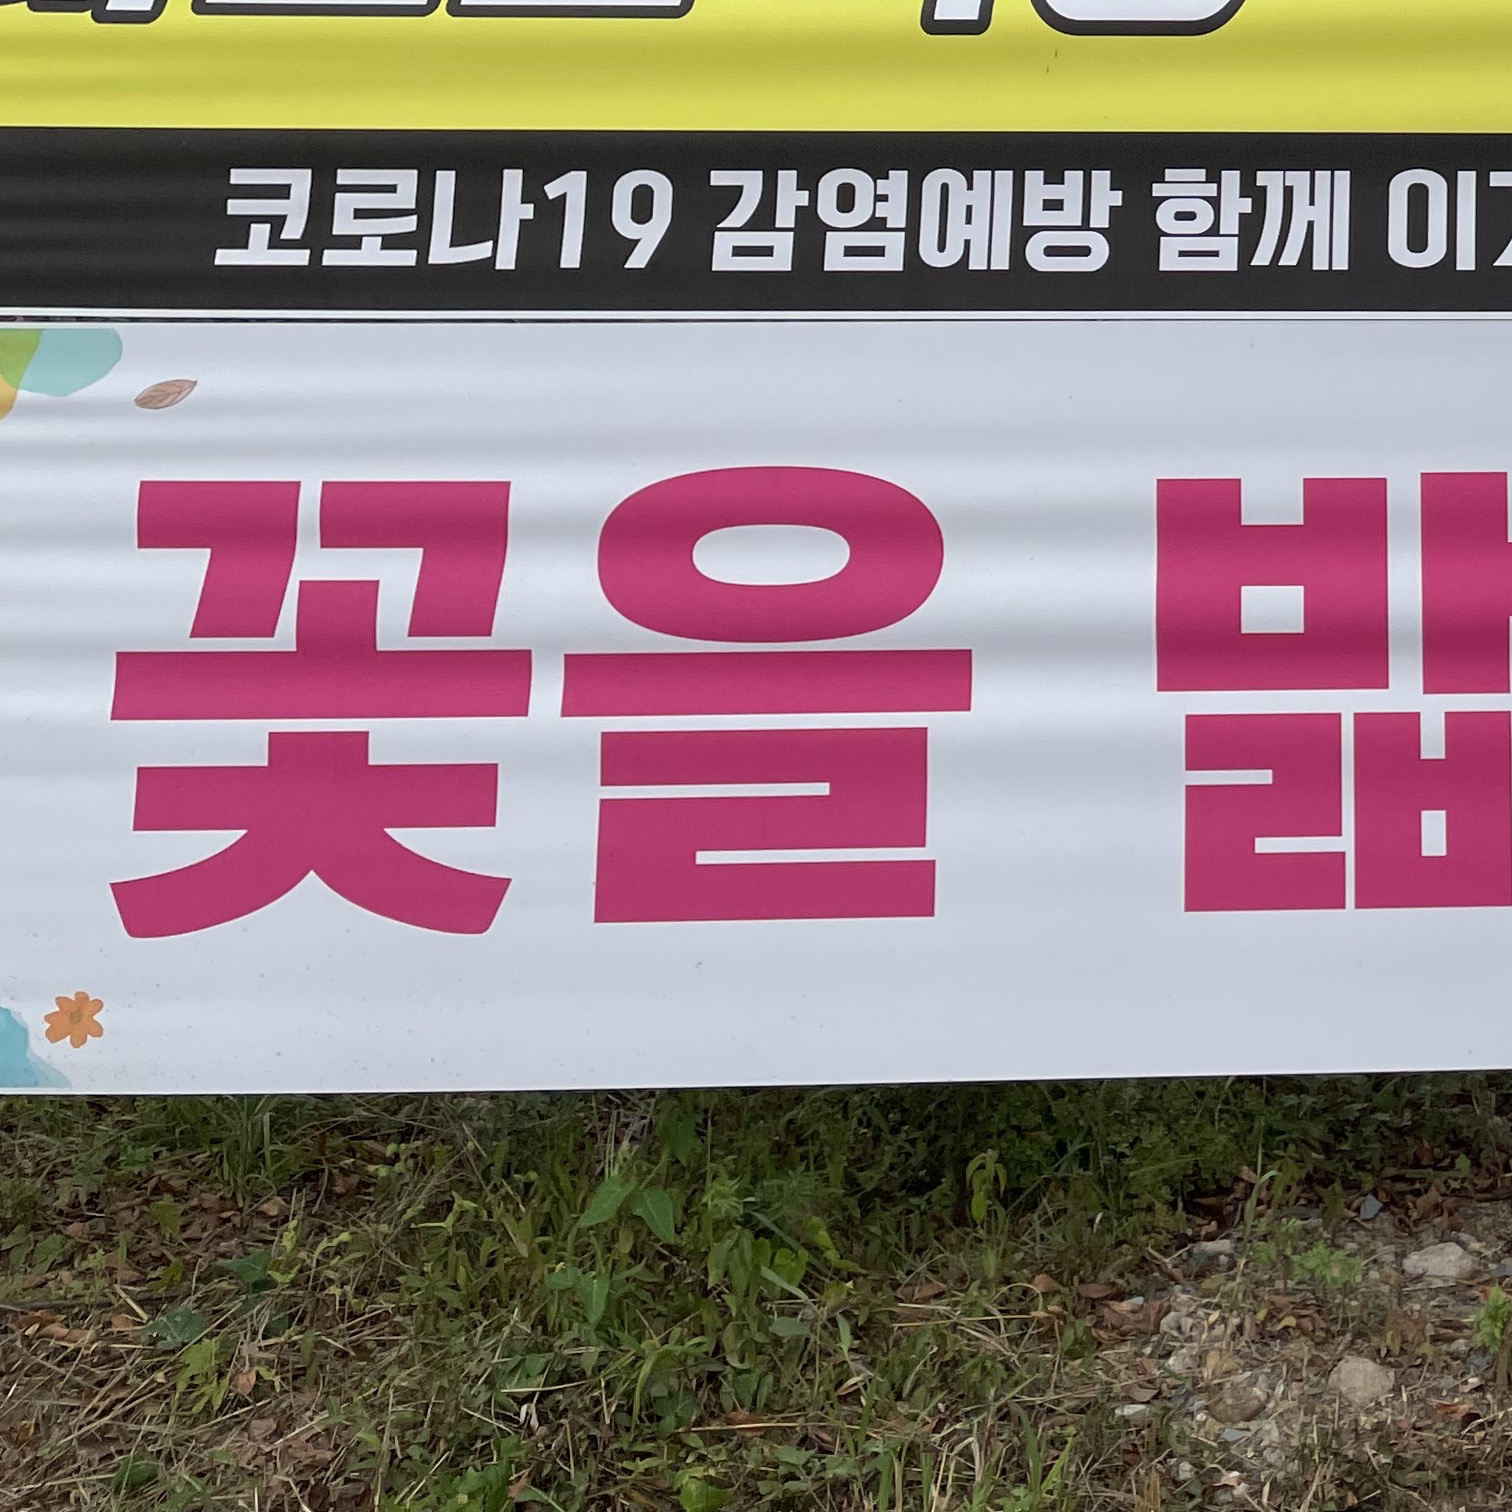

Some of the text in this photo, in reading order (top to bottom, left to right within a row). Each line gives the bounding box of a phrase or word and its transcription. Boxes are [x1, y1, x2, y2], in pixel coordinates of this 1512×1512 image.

[213, 168, 673, 270] 코로나19
[708, 168, 1122, 272] 감염예방
[1151, 168, 1350, 272] 함께
[110, 466, 972, 939] 꽃을
